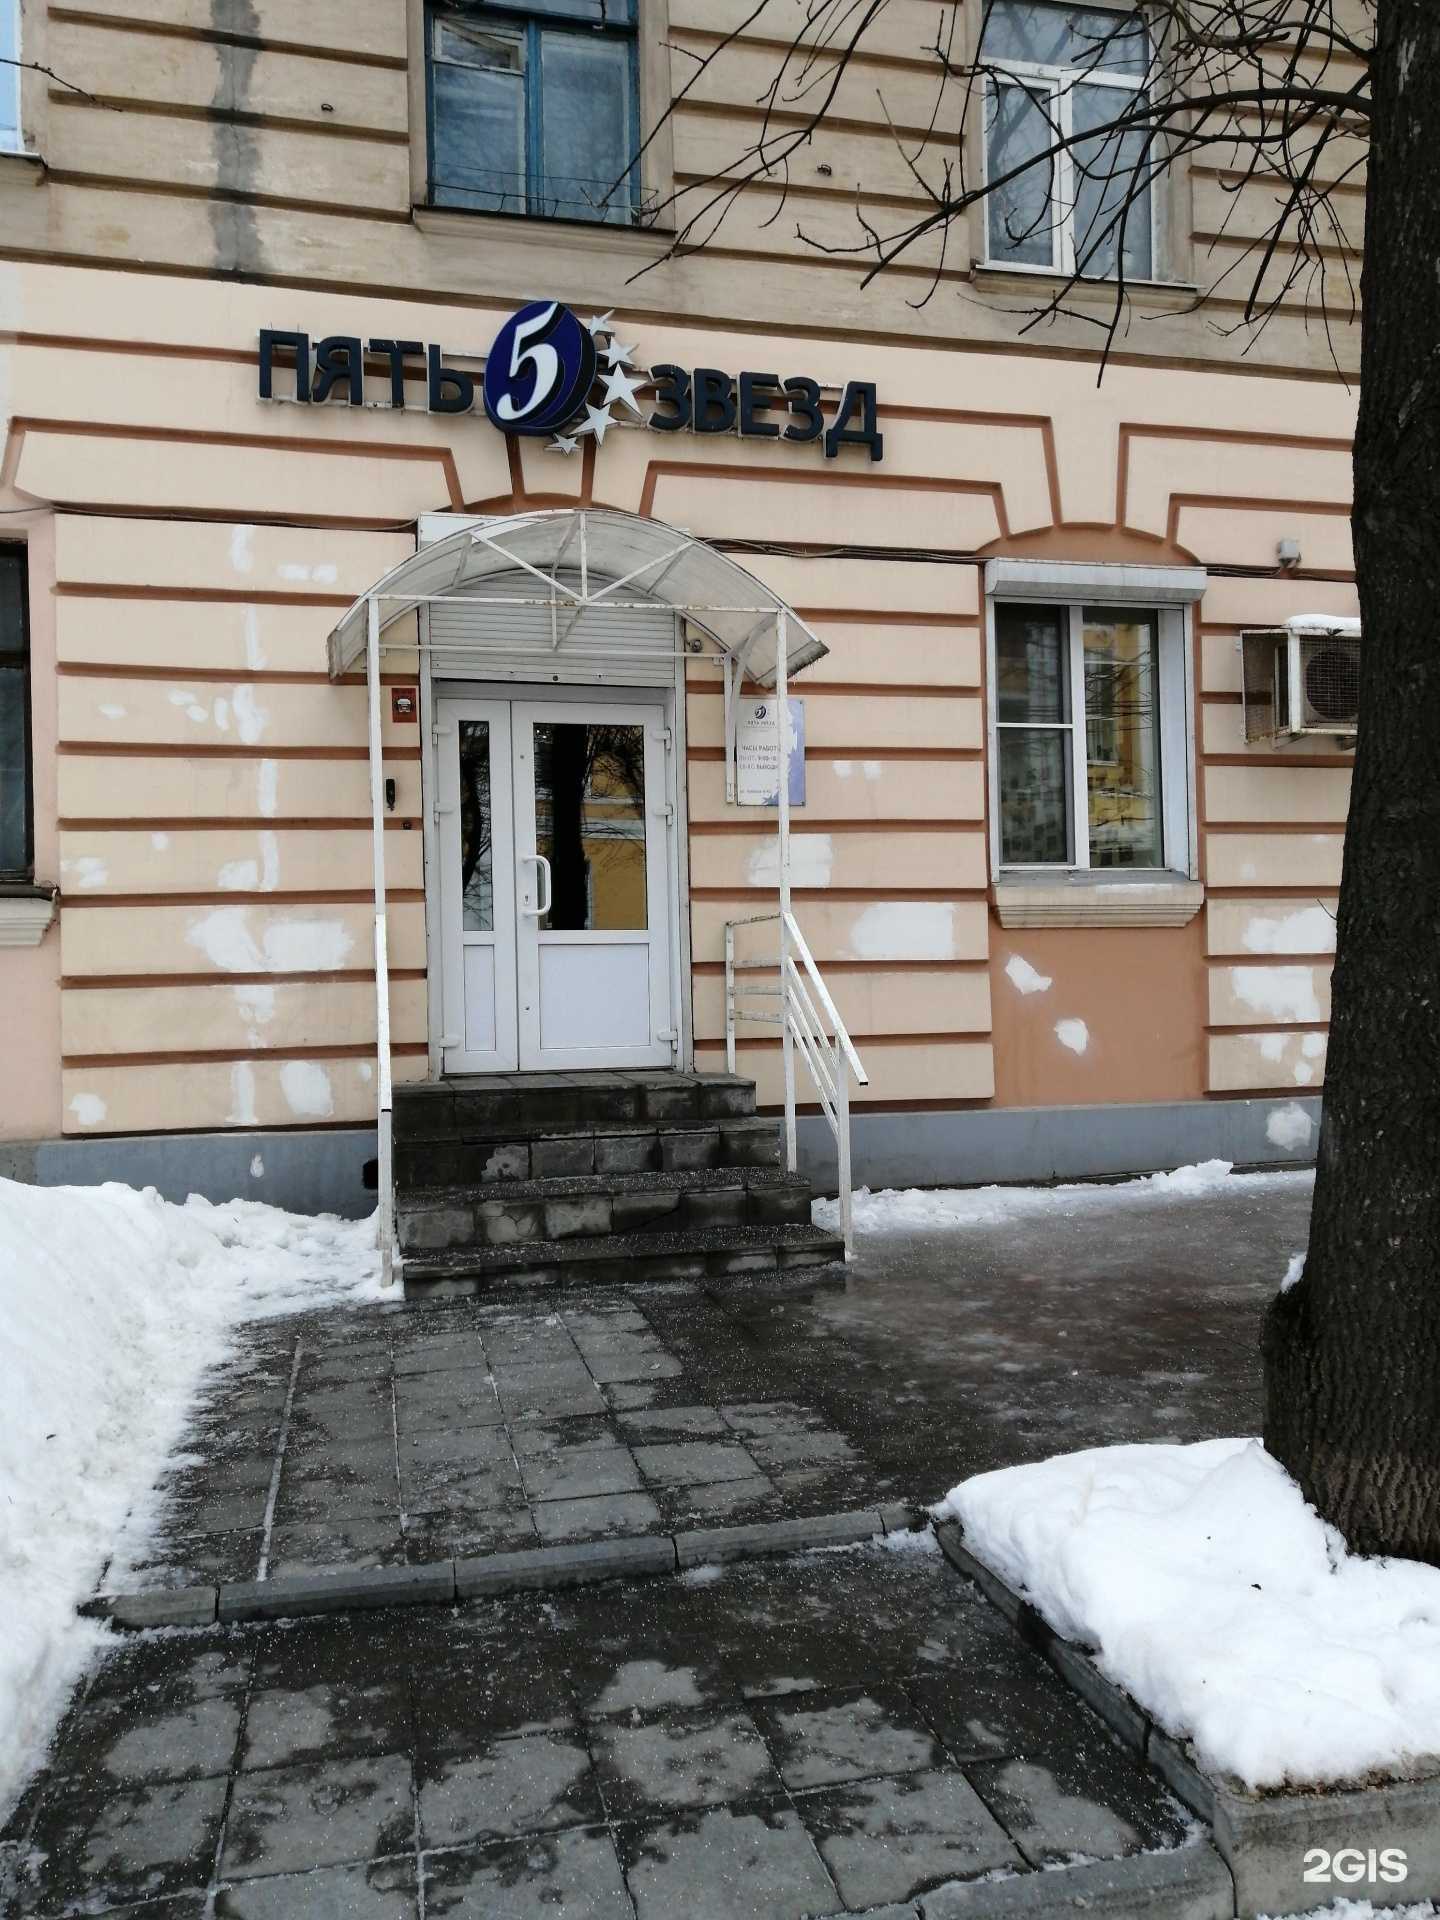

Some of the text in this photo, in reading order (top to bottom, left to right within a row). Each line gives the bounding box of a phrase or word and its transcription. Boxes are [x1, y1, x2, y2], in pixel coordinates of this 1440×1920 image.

[257, 300, 884, 463] ПЯТЬ 5 ЗВЕЗД
